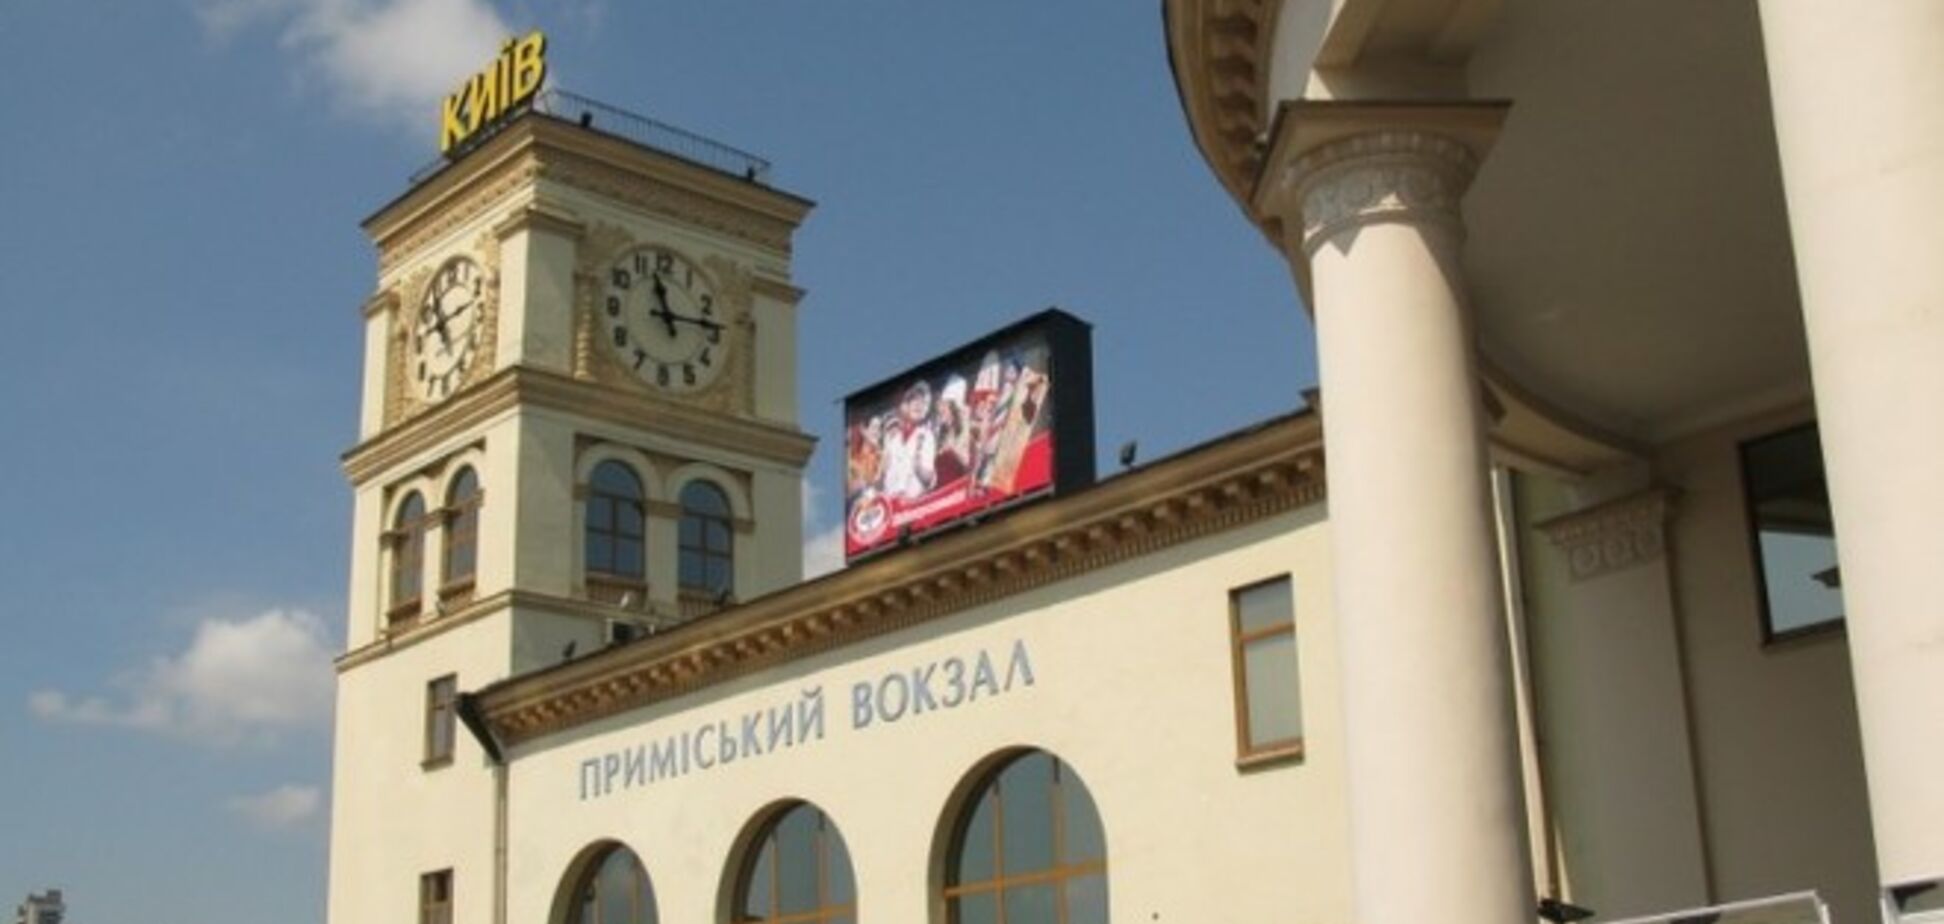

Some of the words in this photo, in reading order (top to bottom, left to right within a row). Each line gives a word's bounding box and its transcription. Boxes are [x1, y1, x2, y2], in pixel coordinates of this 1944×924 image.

[441, 30, 546, 152] КИЇВ
[634, 252, 649, 276] 11
[656, 253, 674, 274] 12
[612, 267, 631, 289] 10
[606, 296, 620, 317] 9
[701, 293, 712, 315] 2
[633, 348, 646, 370] 7
[683, 364, 696, 386] 5
[579, 686, 825, 800] ПРИМІСЬКИЙ
[851, 639, 1034, 730] ВОКЗАЛ
